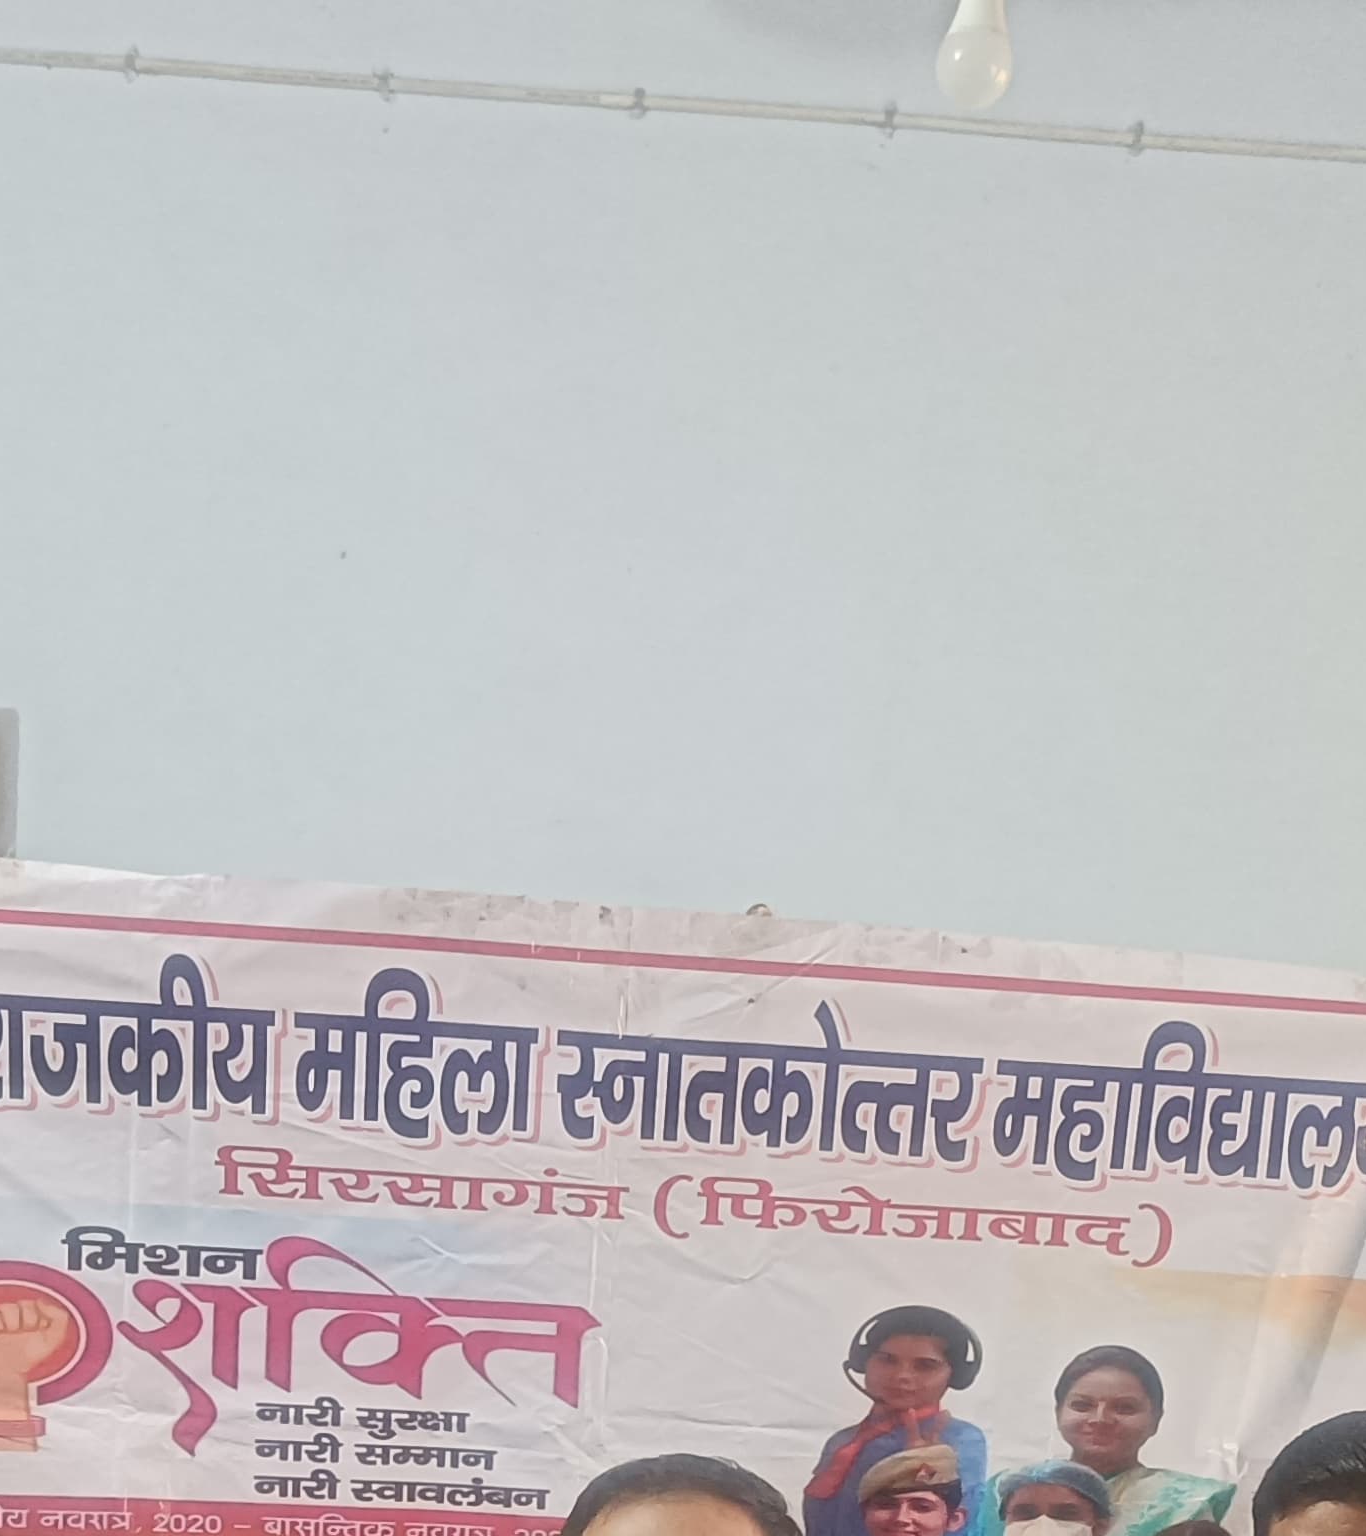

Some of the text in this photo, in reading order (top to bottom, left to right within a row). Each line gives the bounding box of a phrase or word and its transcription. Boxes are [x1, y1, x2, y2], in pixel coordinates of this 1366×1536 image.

[293, 967, 539, 1140] महिला
[557, 999, 984, 1162] स्नातकोत्तर
[216, 1146, 629, 1221] सिरसागंज
[62, 1225, 266, 1280] मिशन
[116, 1236, 602, 1457] शक्ति
[255, 1396, 471, 1440] नारी सुरक्षा
[255, 1432, 498, 1471] नारी सम्मान
[253, 1469, 551, 1510] नारी स्वावलंबन
[152, 1512, 223, 1536] 2020
